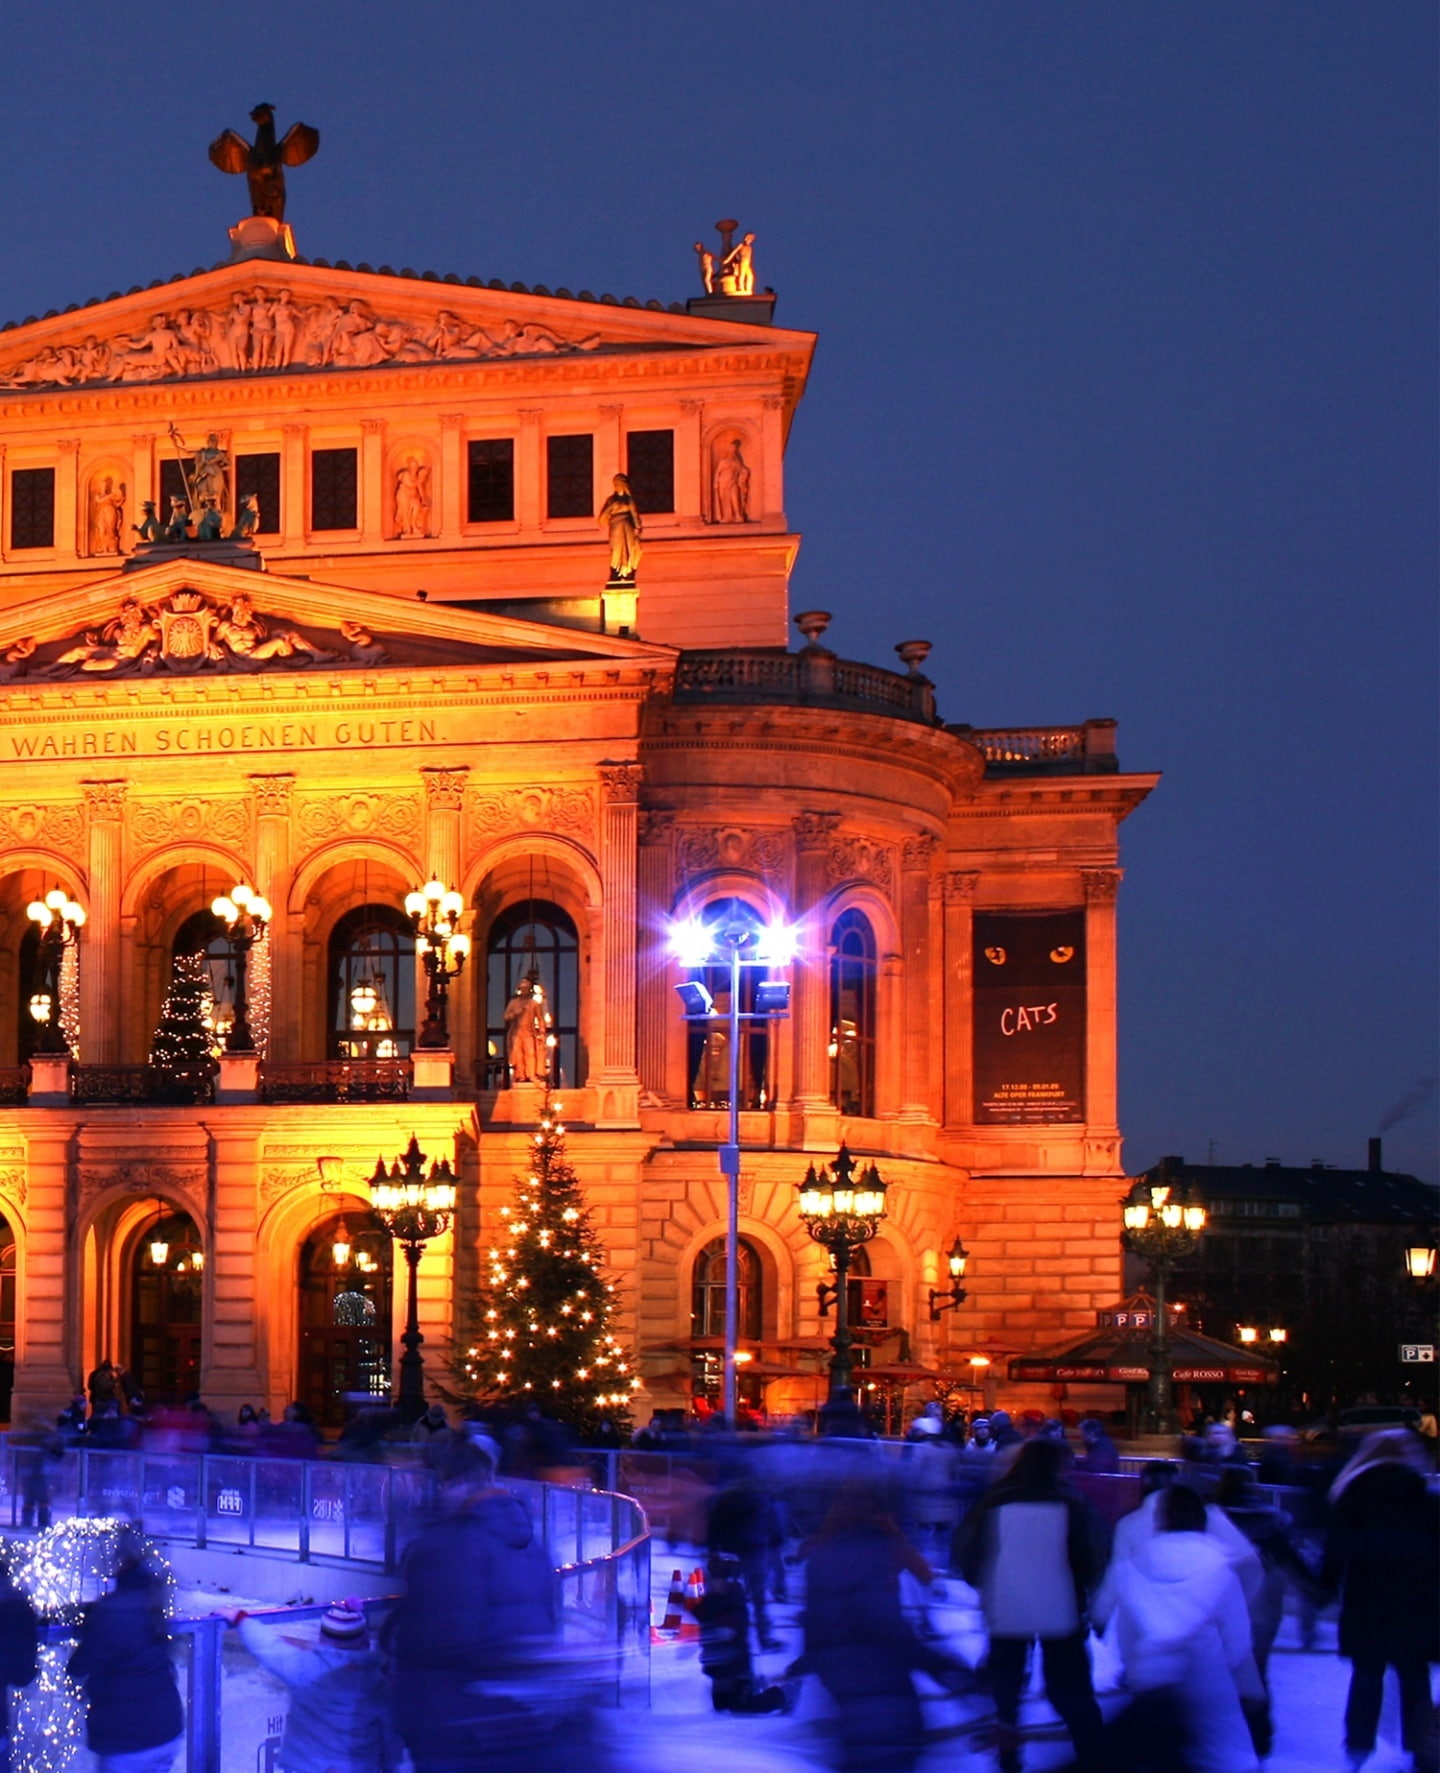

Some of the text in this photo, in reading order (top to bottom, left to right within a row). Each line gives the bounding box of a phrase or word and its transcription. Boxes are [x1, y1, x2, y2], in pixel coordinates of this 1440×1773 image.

[11, 731, 137, 756] WAHREN
[155, 724, 316, 751] SCHOENEN
[335, 719, 447, 744] GUTEN.
[1001, 1002, 1058, 1035] CATS
[1027, 1090, 1065, 1098] FRANKFURT
[1193, 1370, 1224, 1379] ROSSO
